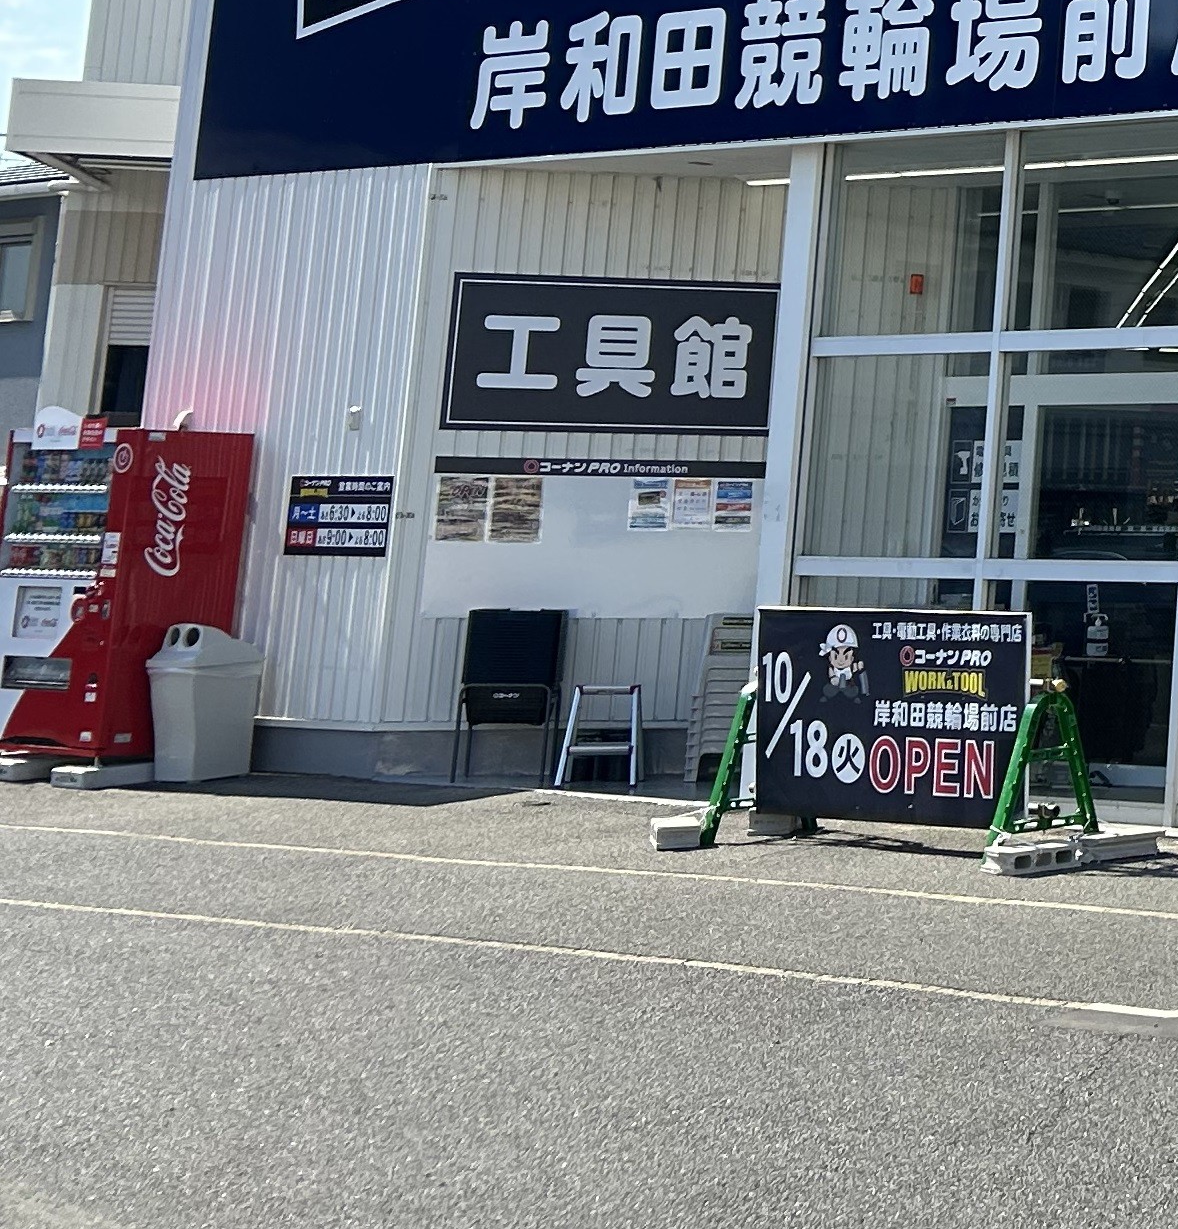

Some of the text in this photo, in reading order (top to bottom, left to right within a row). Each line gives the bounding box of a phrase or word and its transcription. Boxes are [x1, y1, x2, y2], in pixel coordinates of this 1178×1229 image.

[476, 314, 753, 398] 工具館
[623, 463, 689, 474] Information
[143, 455, 192, 577] Coca-Cola
[873, 699, 1018, 732] 岸和田競輪場前店
[869, 735, 995, 799] OPEN
